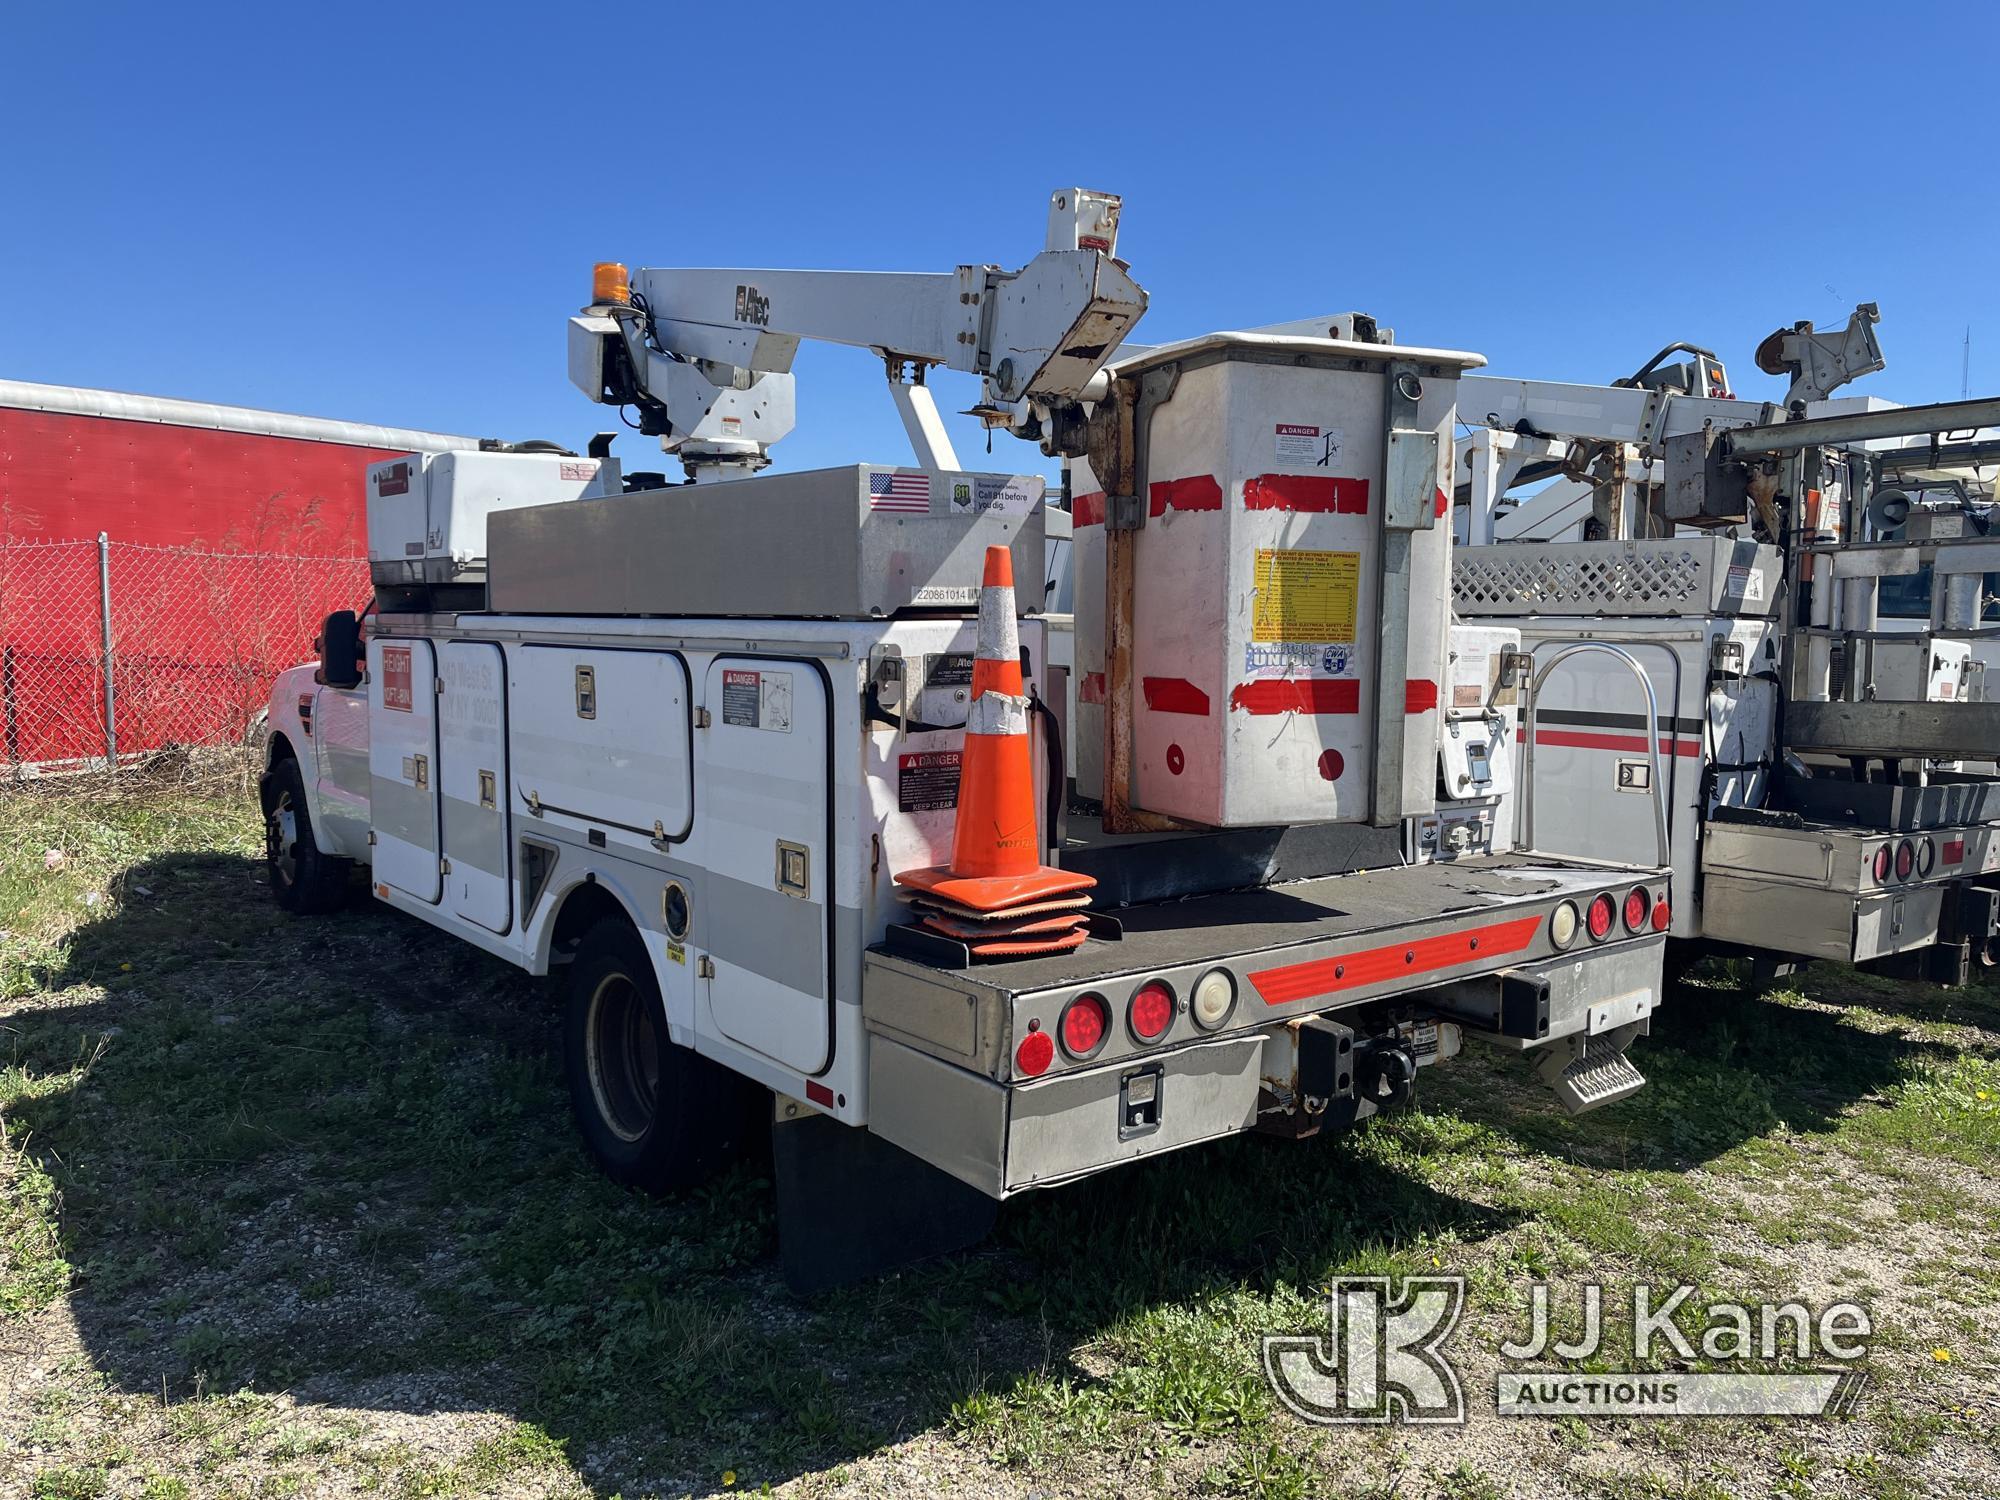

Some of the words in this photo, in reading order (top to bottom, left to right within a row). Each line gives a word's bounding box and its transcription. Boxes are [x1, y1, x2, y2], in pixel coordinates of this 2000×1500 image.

[1288, 427, 1315, 435] DANGER
[954, 484, 970, 500] 811
[978, 490, 992, 500] Call
[993, 492, 1004, 500] 811
[1005, 493, 1028, 501] before
[978, 502, 992, 510] you
[918, 590, 965, 600] 220861014
[1326, 649, 1345, 659] CWA
[383, 653, 410, 673] HEIGHT
[1252, 654, 1317, 667] UNION
[733, 673, 755, 685] DANGER
[919, 754, 959, 766] DANGER
[913, 803, 930, 811] KEEP
[931, 800, 953, 809] CLEAR
